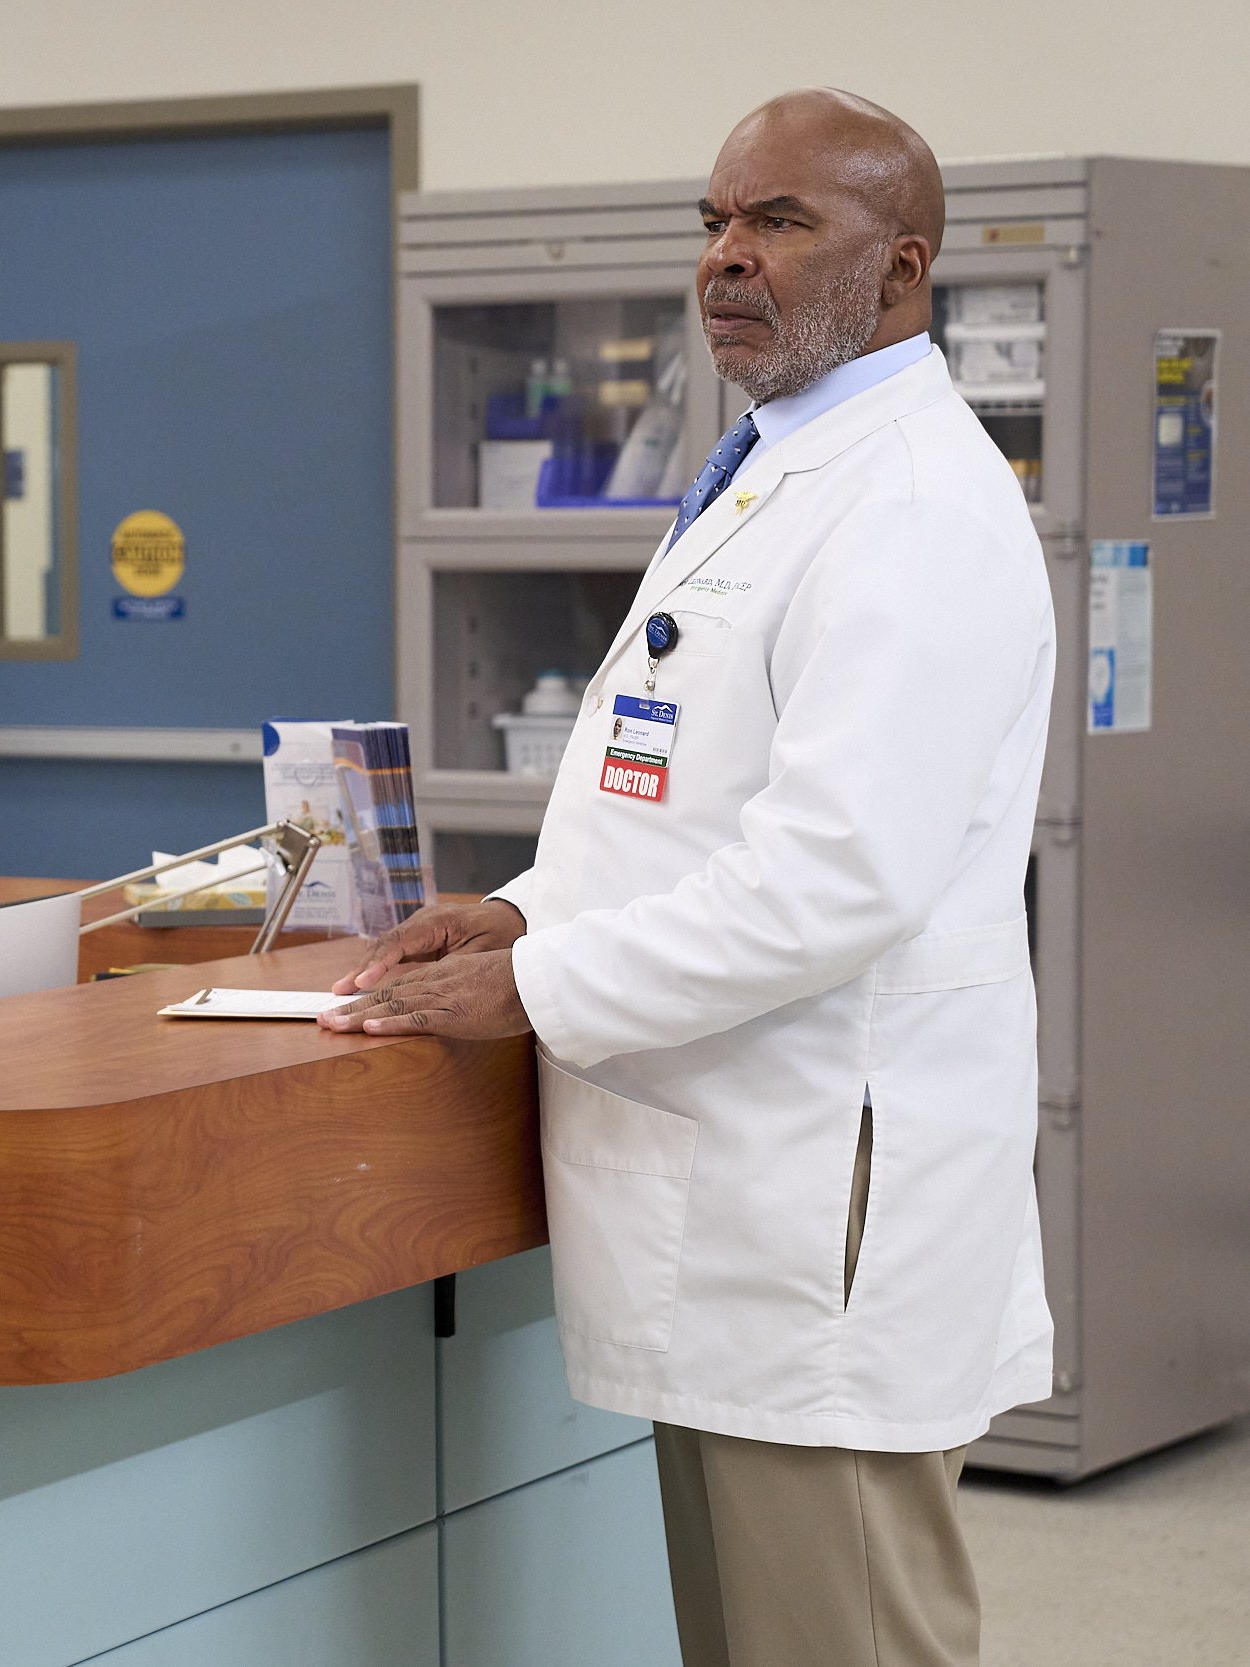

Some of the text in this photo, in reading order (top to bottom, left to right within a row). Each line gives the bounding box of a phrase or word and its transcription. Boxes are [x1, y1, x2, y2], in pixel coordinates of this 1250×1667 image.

[610, 748, 662, 766] Emergency Department
[604, 766, 660, 798] DOCTOR
